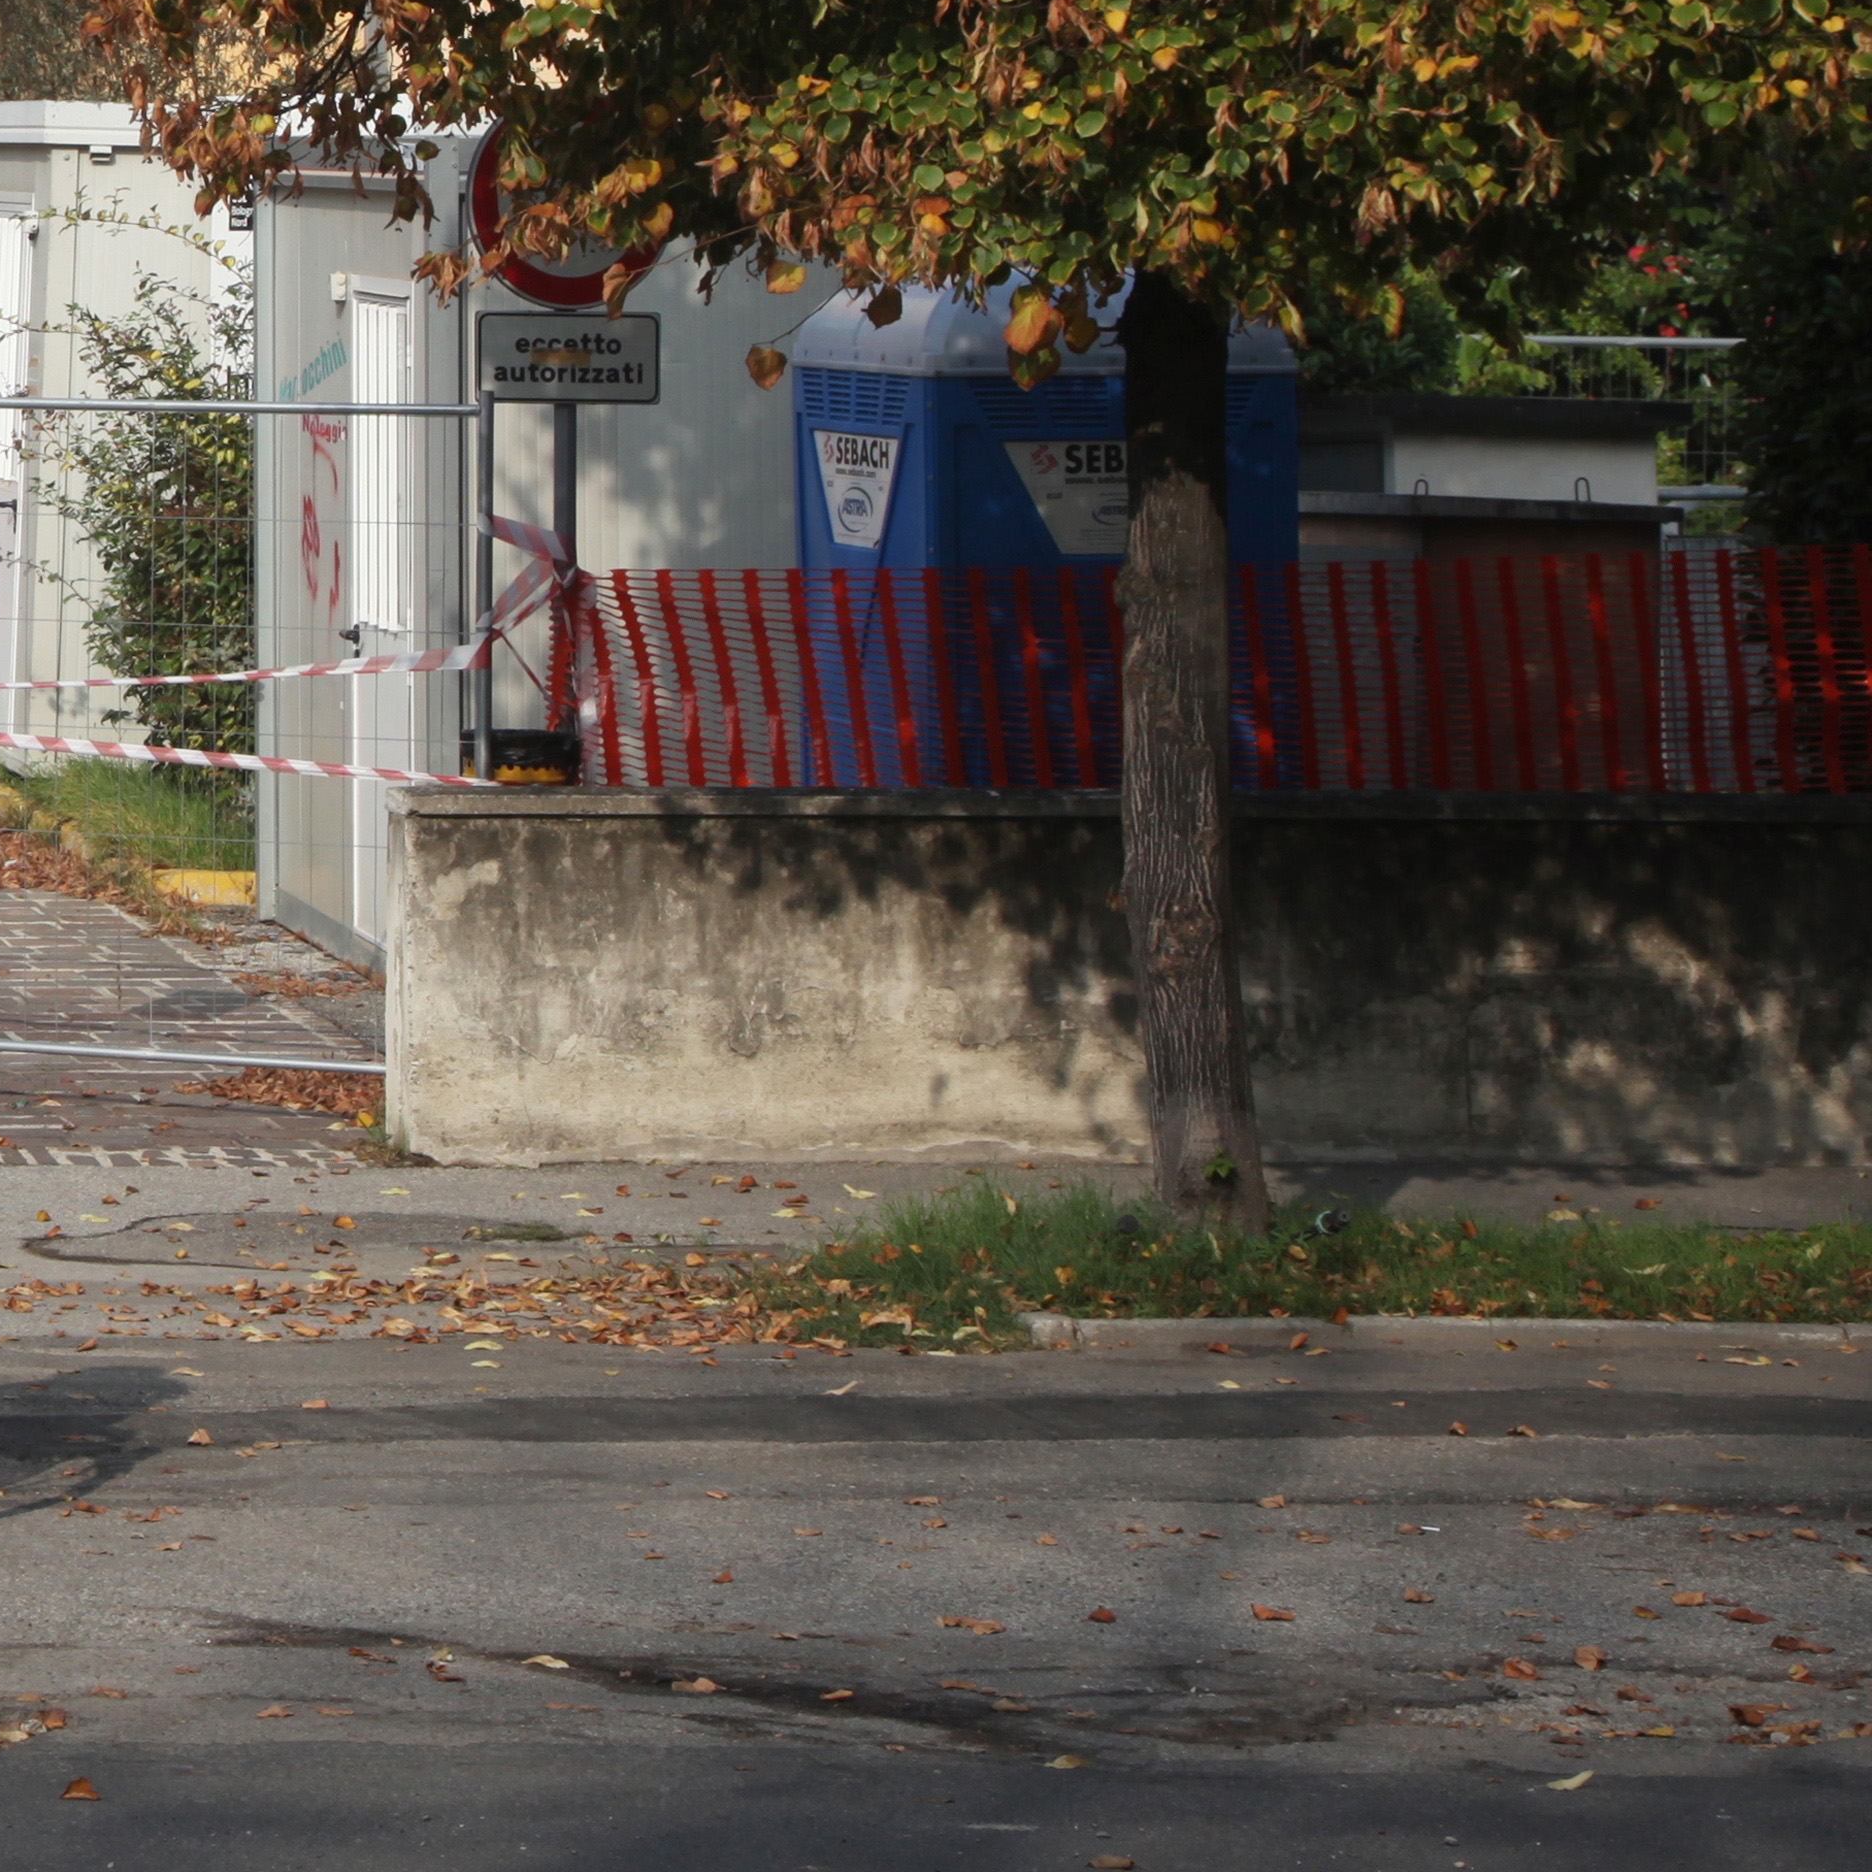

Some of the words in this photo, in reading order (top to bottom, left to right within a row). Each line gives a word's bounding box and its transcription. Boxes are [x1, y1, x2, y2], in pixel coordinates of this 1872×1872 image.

[515, 333, 622, 355] eccetto
[494, 363, 644, 384] autorizzati
[836, 435, 890, 469] SEBACH
[1065, 444, 1125, 474] SEB
